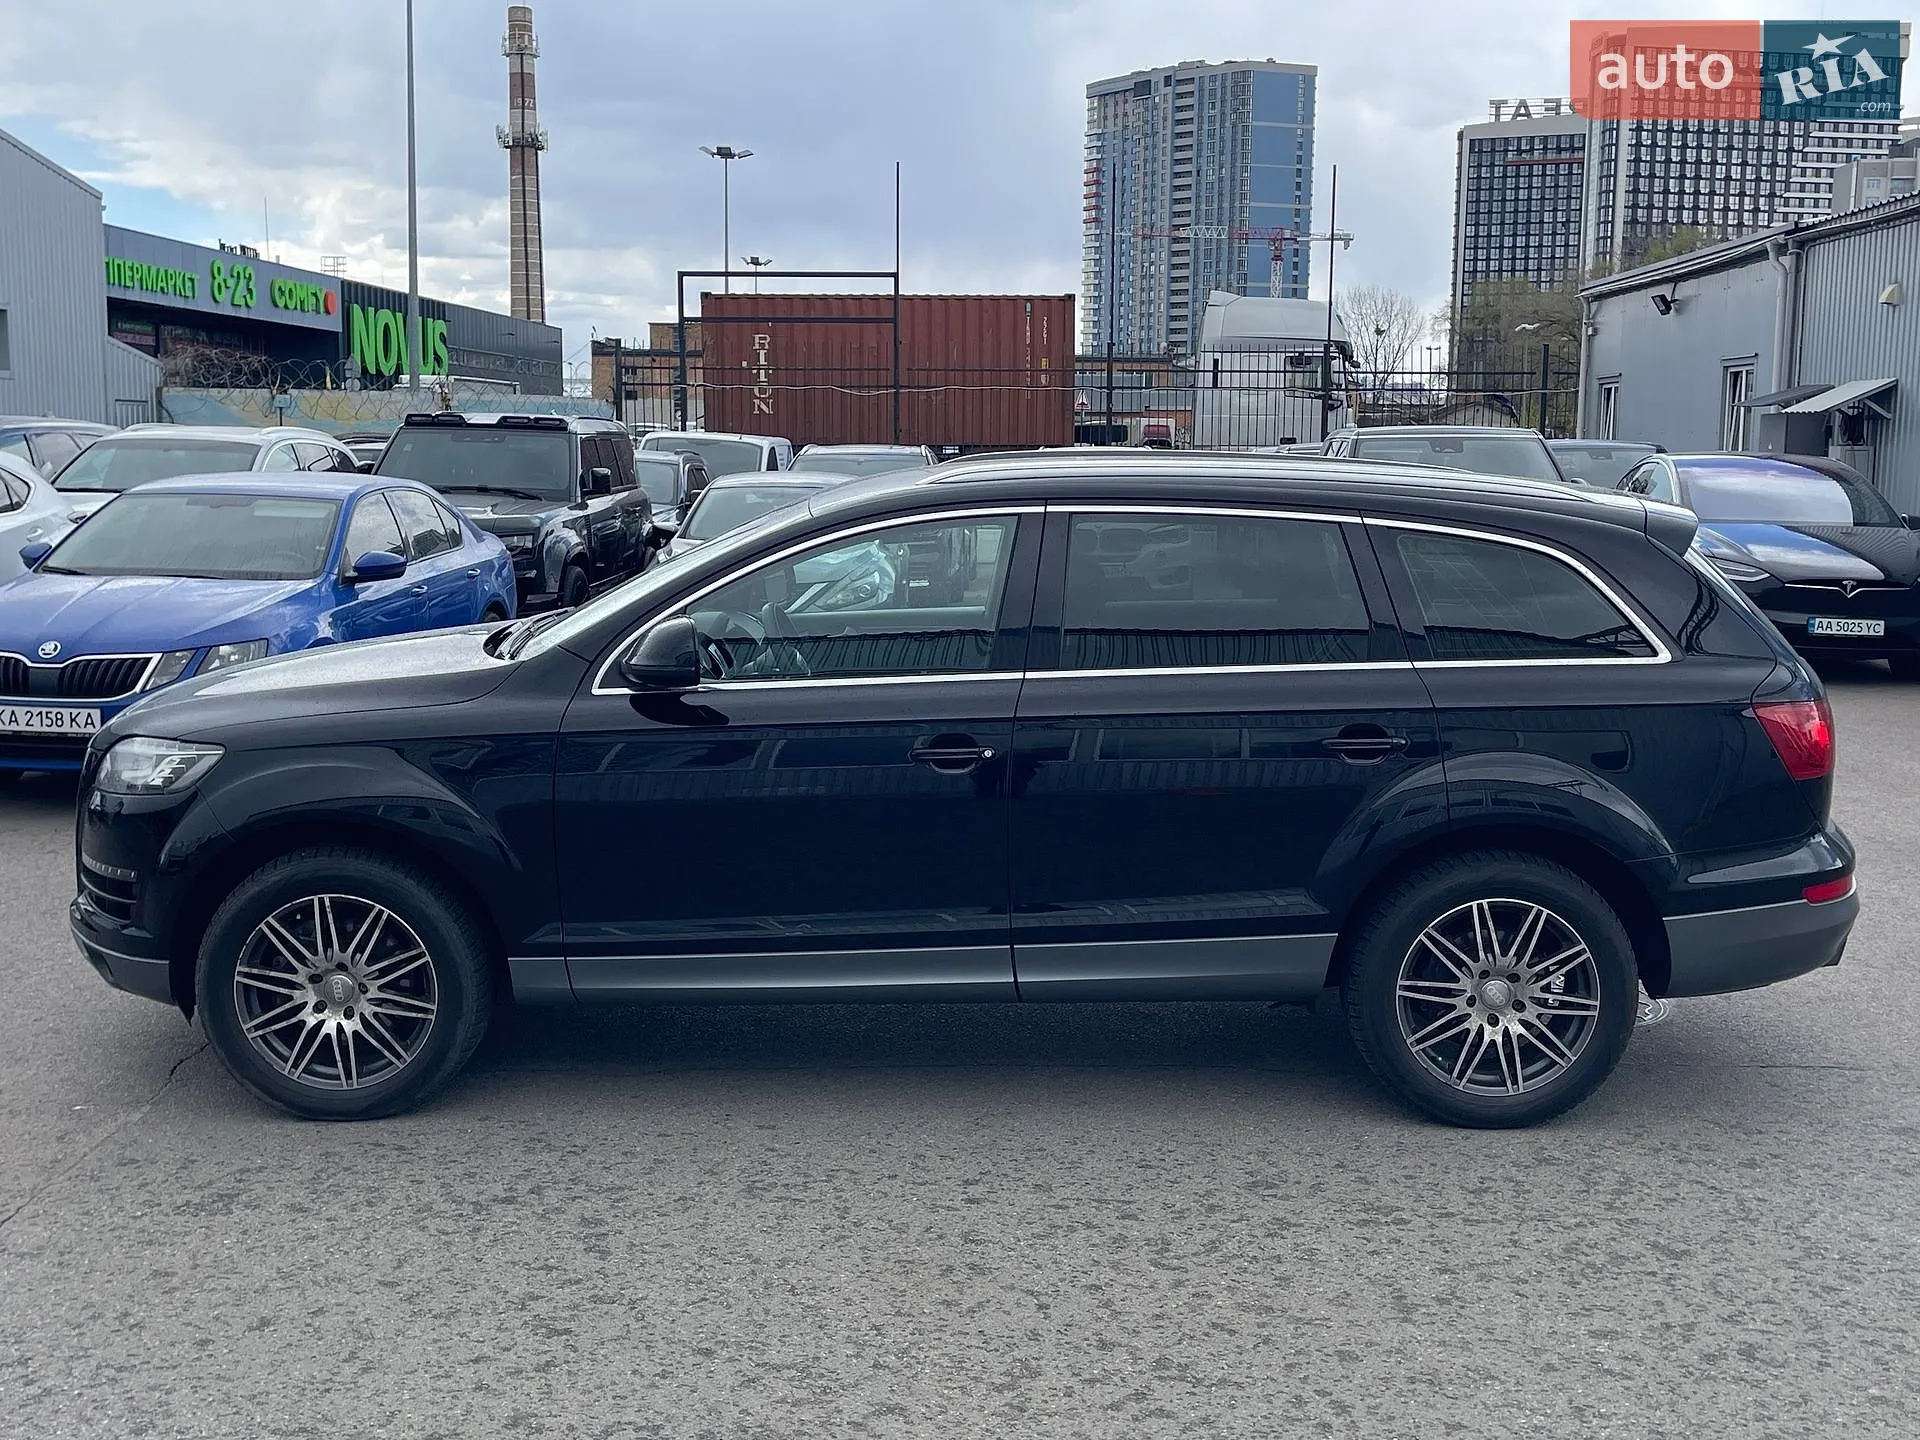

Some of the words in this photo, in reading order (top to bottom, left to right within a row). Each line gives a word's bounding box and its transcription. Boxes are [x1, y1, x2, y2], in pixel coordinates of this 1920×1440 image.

[210, 258, 257, 308] 8-23
[271, 277, 325, 316] COMFY
[350, 304, 448, 376] NOVUS
[1817, 621, 1833, 632] AA
[1836, 621, 1863, 633] 5025
[1866, 622, 1881, 634] YC
[25, 710, 64, 728] 2158
[70, 711, 96, 729] KA
